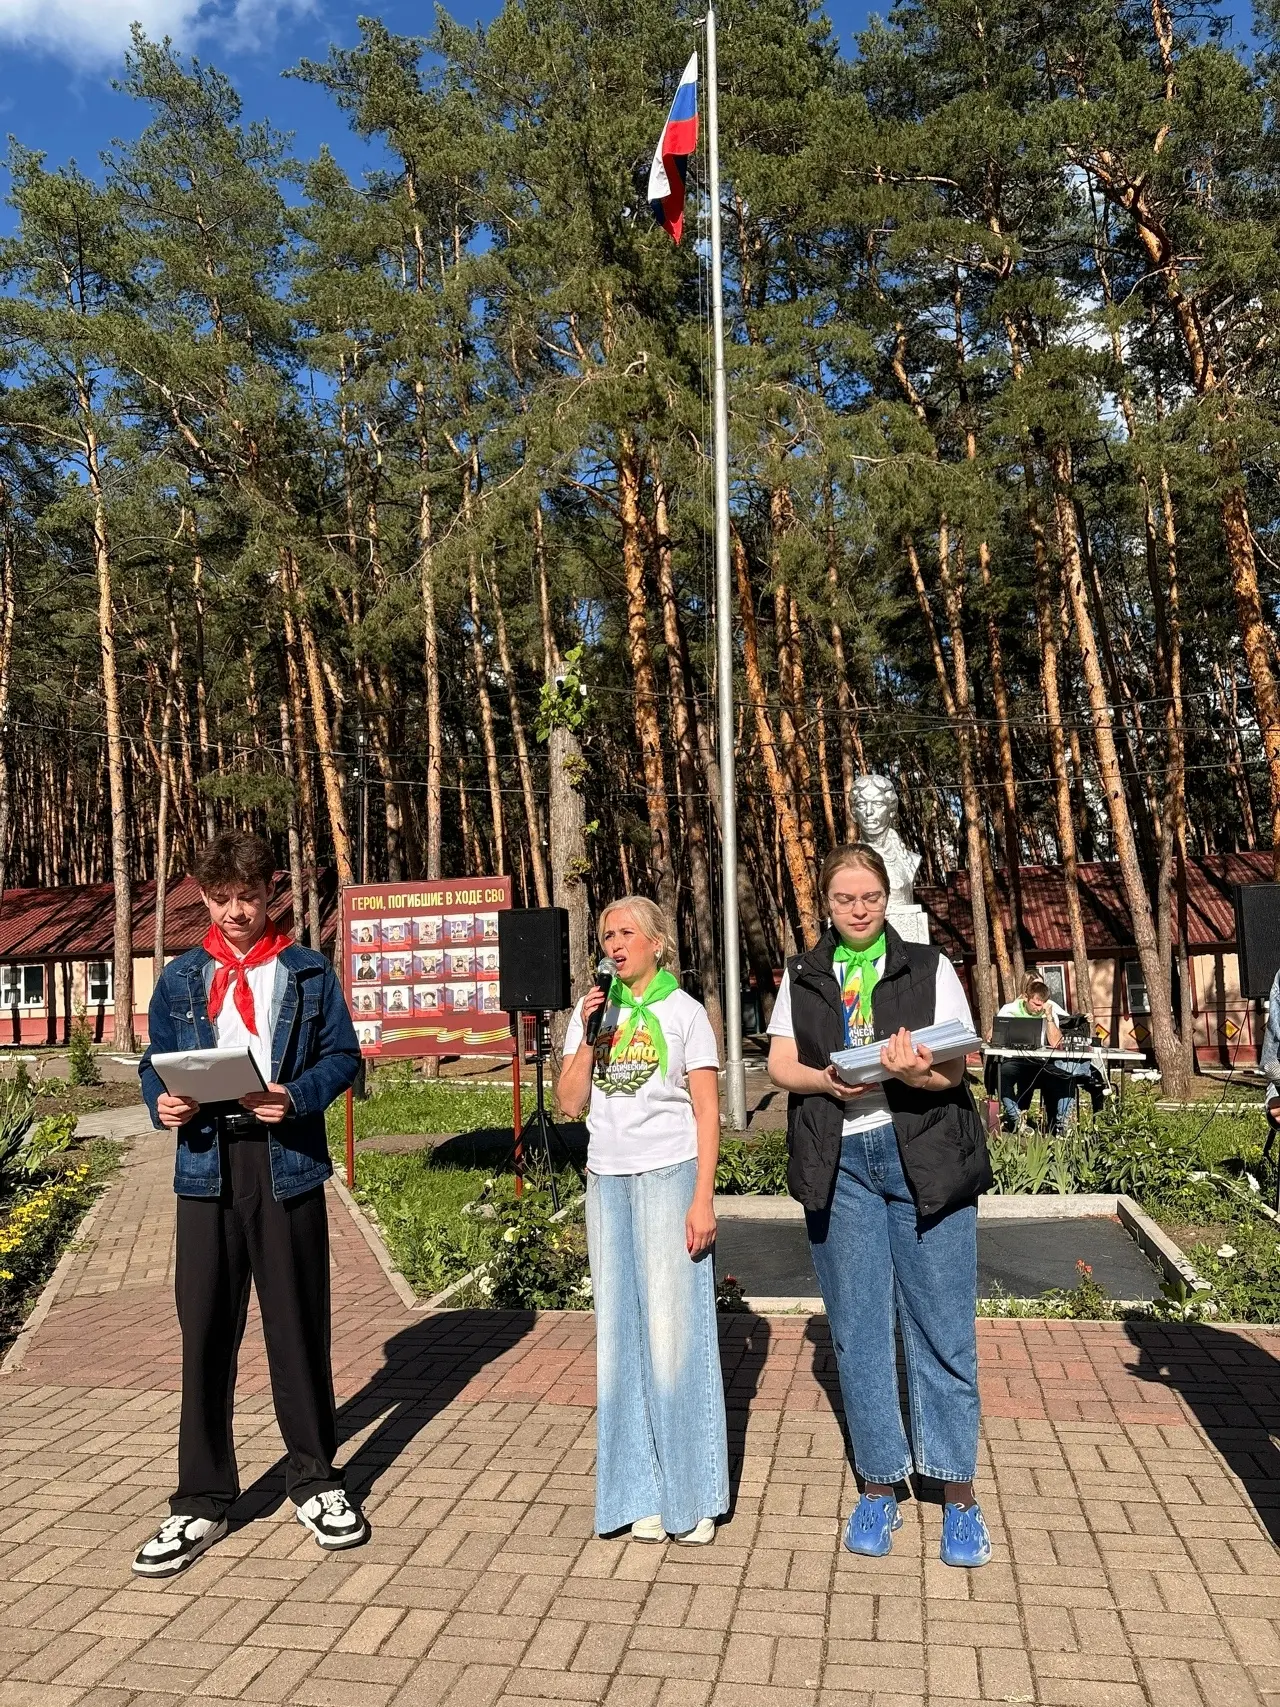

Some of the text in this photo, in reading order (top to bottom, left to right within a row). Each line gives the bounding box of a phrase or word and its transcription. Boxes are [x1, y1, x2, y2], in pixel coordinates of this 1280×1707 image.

[351, 888, 505, 911] ГЕРОИ, ПОГИБШИЕ В ХОДЕ СВО
